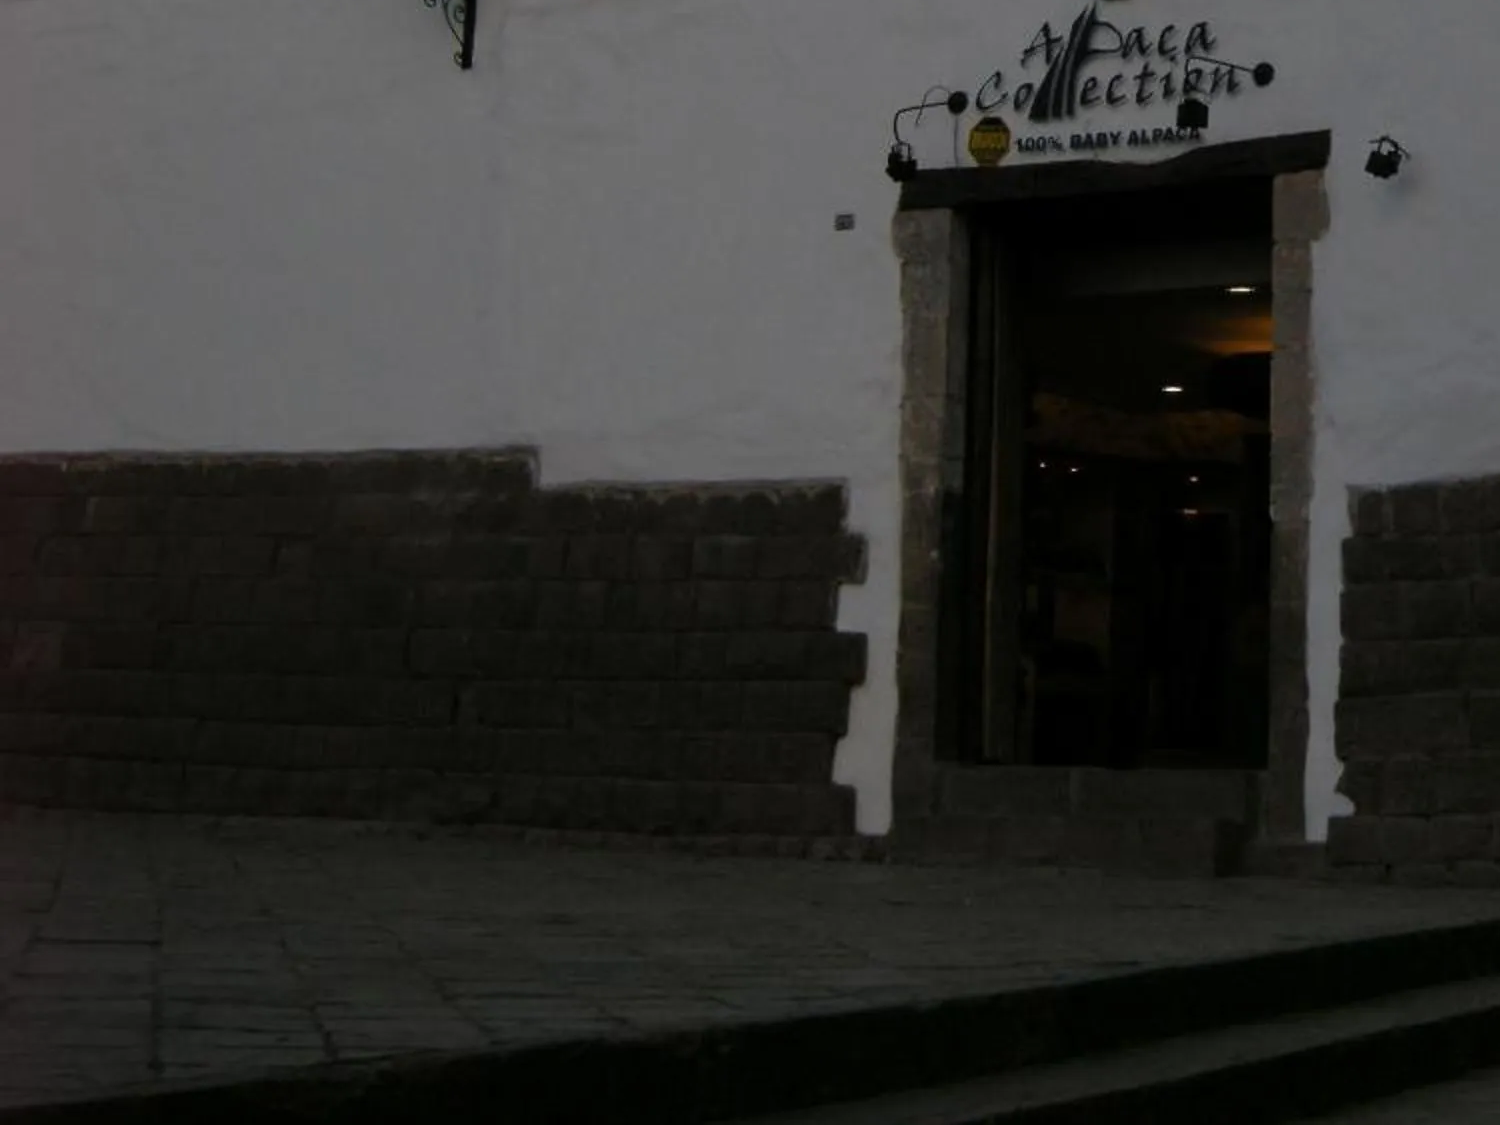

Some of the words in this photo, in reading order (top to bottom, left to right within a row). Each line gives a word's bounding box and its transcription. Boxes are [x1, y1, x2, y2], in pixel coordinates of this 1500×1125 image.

[1016, 135, 1064, 153] 100%
[1070, 131, 1122, 150] BABY
[1127, 126, 1201, 147] ALPACA
